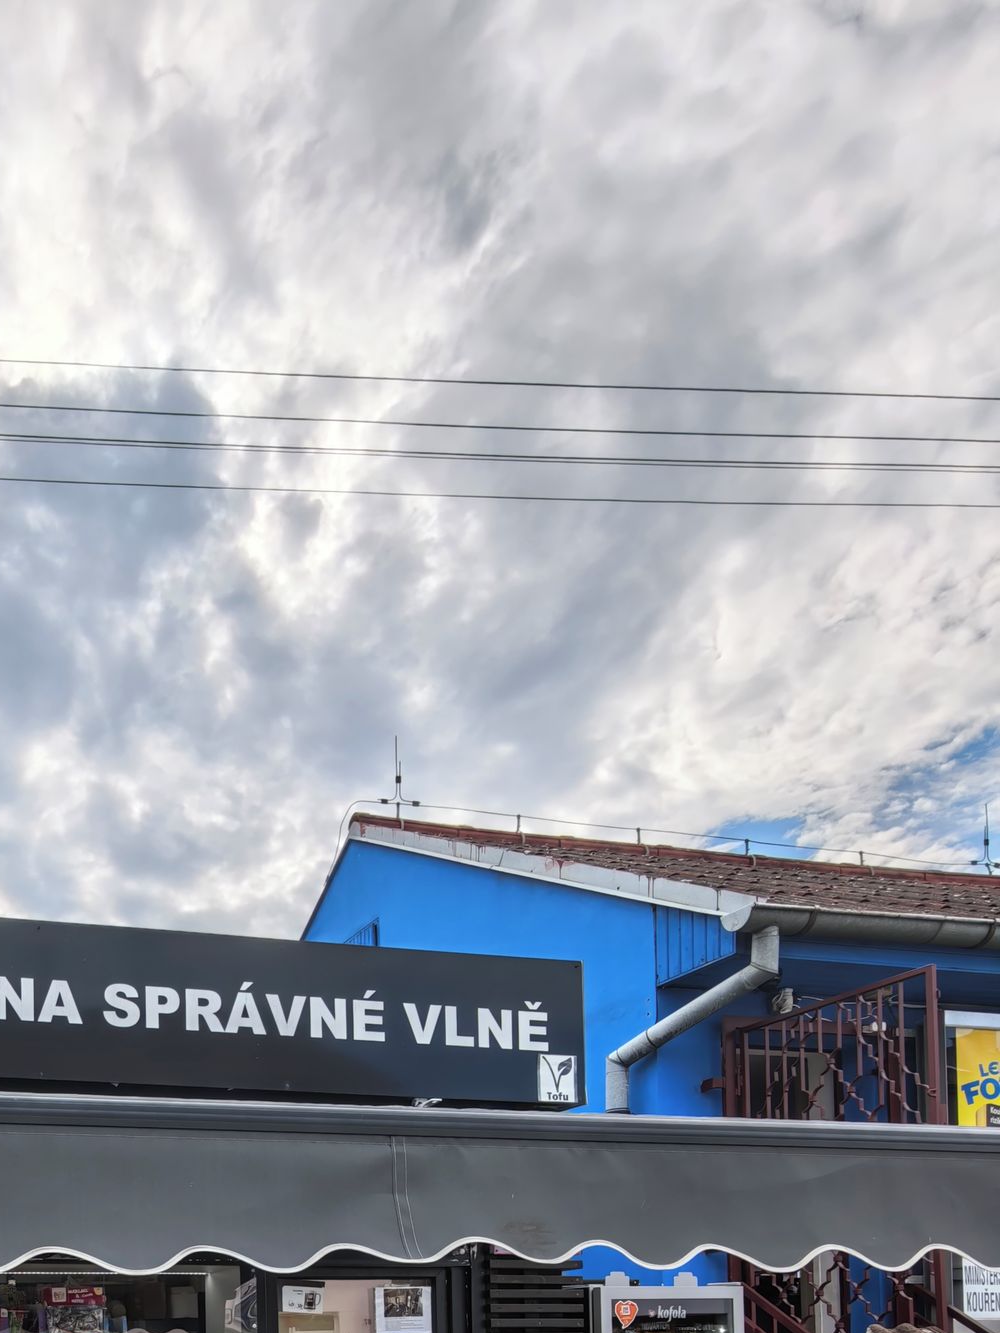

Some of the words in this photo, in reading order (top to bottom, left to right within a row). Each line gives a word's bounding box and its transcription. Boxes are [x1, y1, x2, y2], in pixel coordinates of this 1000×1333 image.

[103, 981, 386, 1042] SPRÁVNÉ
[403, 1001, 549, 1052] VLNĚ
[547, 1092, 569, 1101] Tofu
[657, 1305, 687, 1322] kofola
